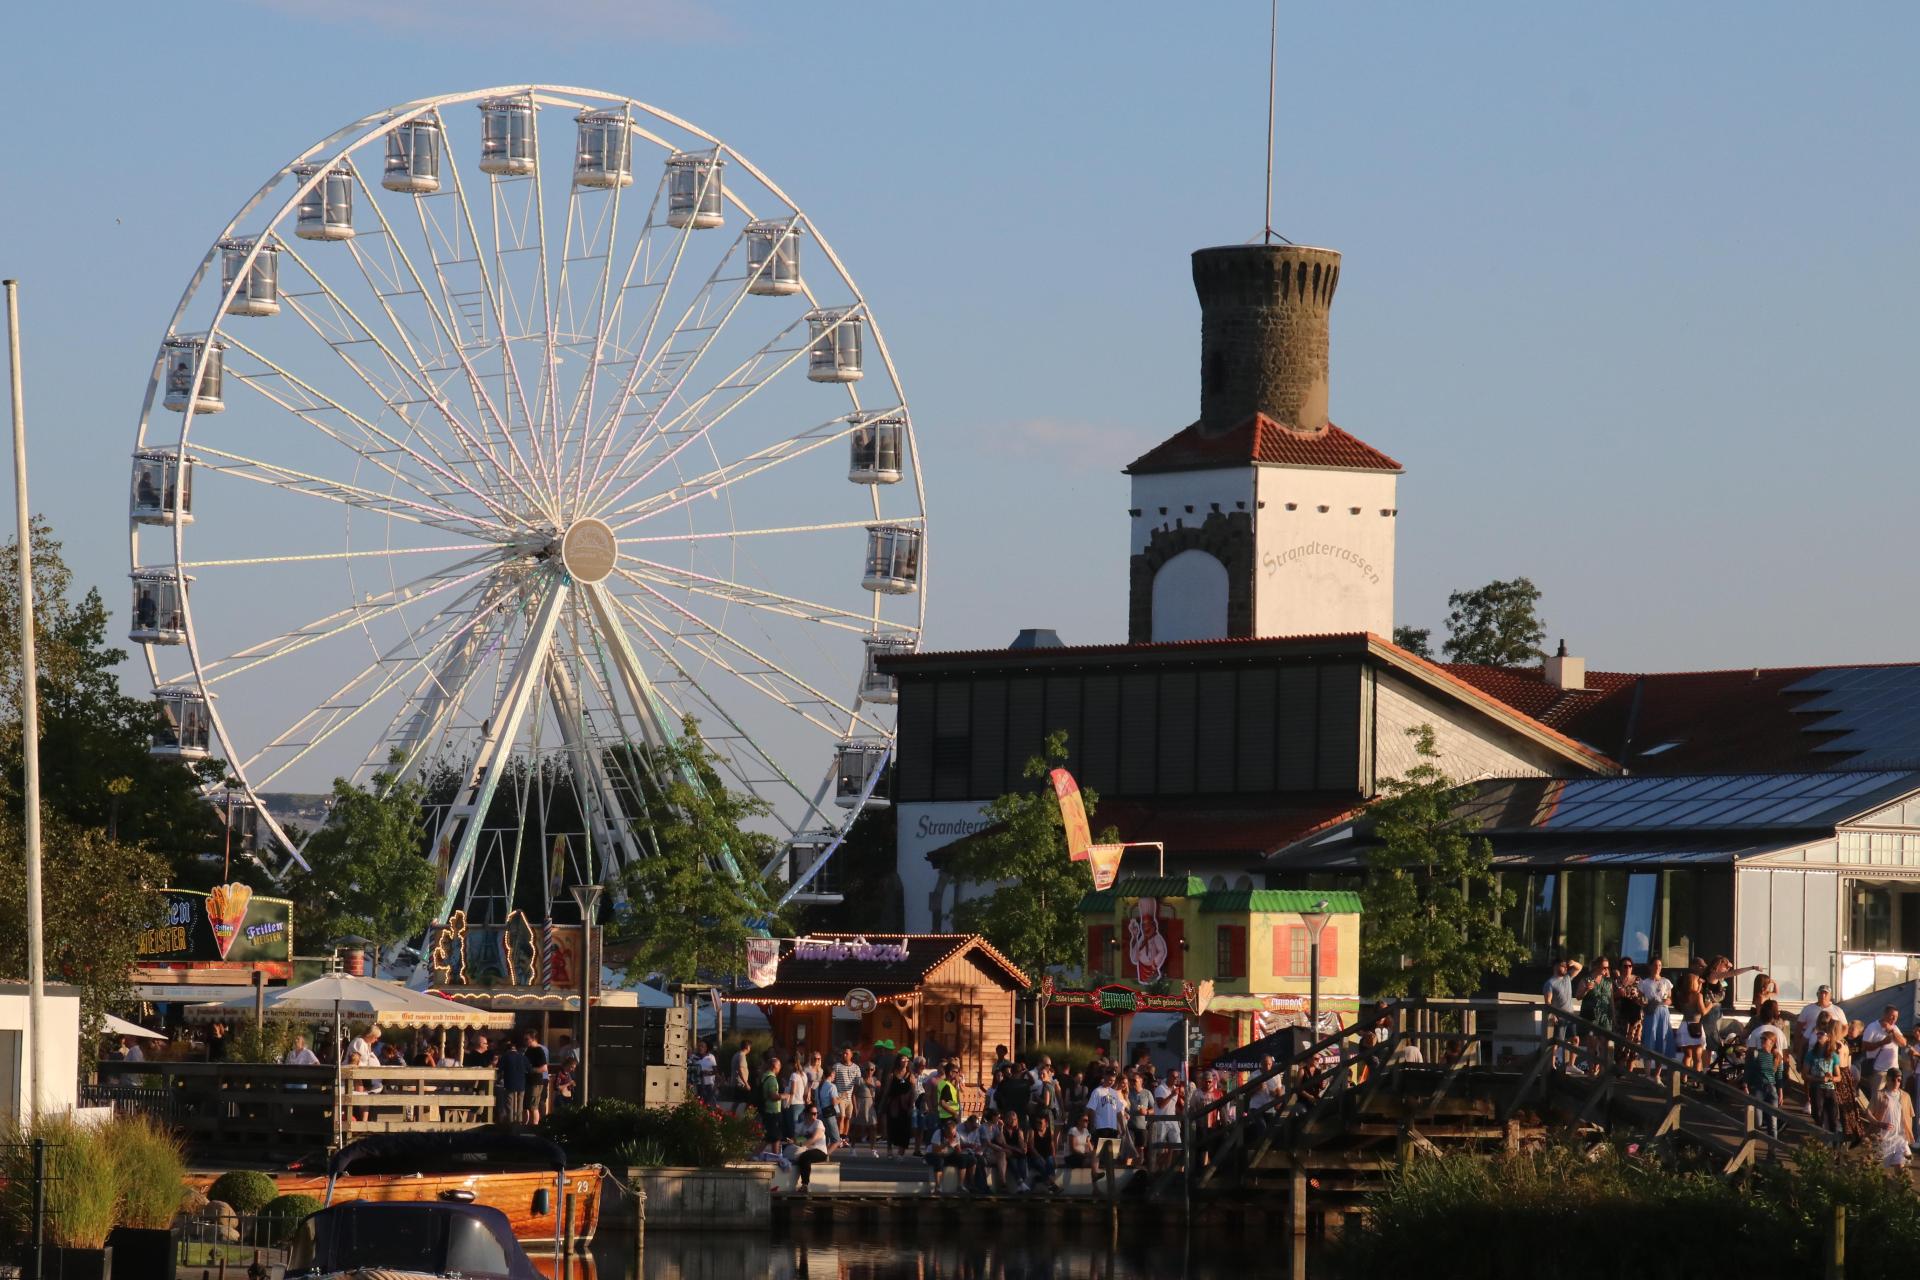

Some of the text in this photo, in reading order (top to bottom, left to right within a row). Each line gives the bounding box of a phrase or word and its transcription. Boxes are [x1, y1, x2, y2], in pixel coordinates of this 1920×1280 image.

[1262, 541, 1380, 585] Strandterrassen
[916, 815, 991, 838] Strandterr
[247, 922, 284, 939] Fritten
[1101, 991, 1137, 1011] CHURROS
[1271, 997, 1303, 1011] CHURROS
[577, 1180, 589, 1193] 29
